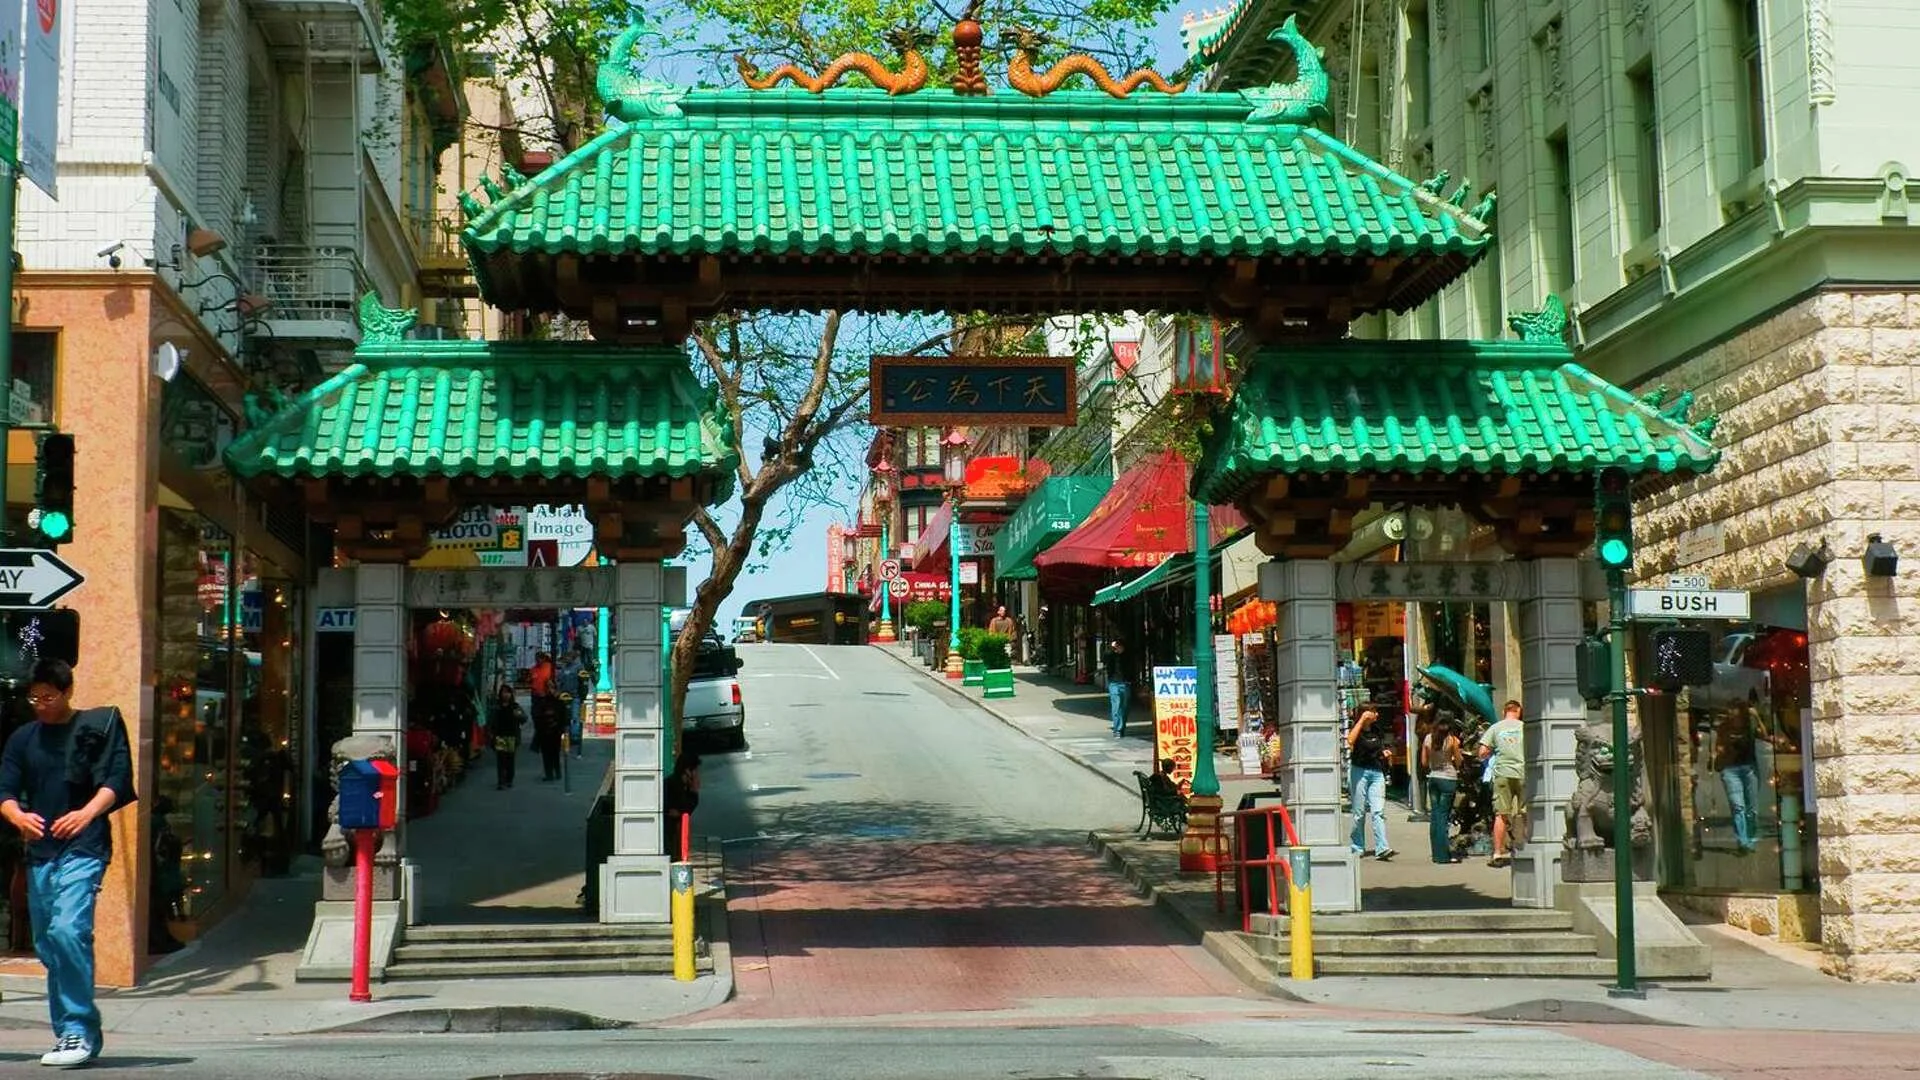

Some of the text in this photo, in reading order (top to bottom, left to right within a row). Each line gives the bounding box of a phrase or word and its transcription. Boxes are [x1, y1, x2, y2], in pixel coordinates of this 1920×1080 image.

[431, 523, 493, 539] HOTO
[533, 521, 583, 537] Image
[1684, 577, 1706, 587] 500
[1661, 595, 1717, 611] BUSH
[1160, 683, 1197, 695] ATM
[1160, 716, 1196, 737] DIGITA
